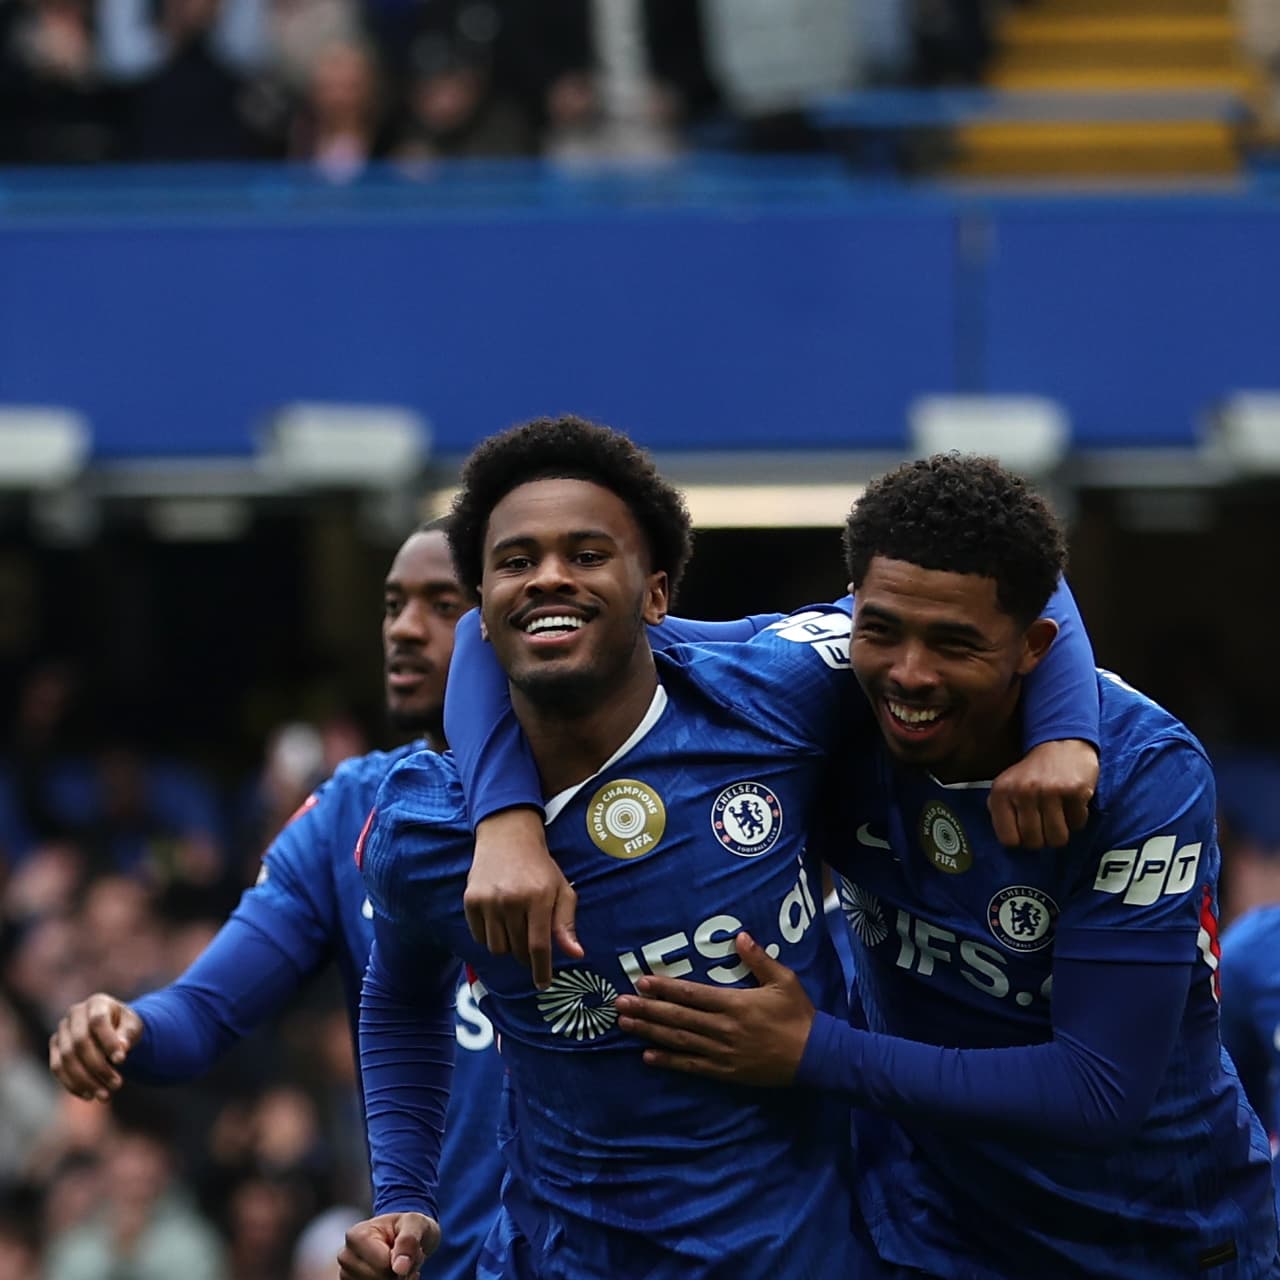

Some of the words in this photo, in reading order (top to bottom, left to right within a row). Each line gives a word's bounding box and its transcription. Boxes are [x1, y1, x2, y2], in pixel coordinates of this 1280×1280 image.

[716, 783, 759, 812] CHELSEA
[593, 802, 609, 841] WORLD
[602, 785, 659, 815] CHAMPIONS
[623, 831, 654, 854] FIFA
[934, 851, 958, 870] FIFA
[999, 888, 1047, 903] CHELSEA
[896, 909, 1054, 1007] IFS.
